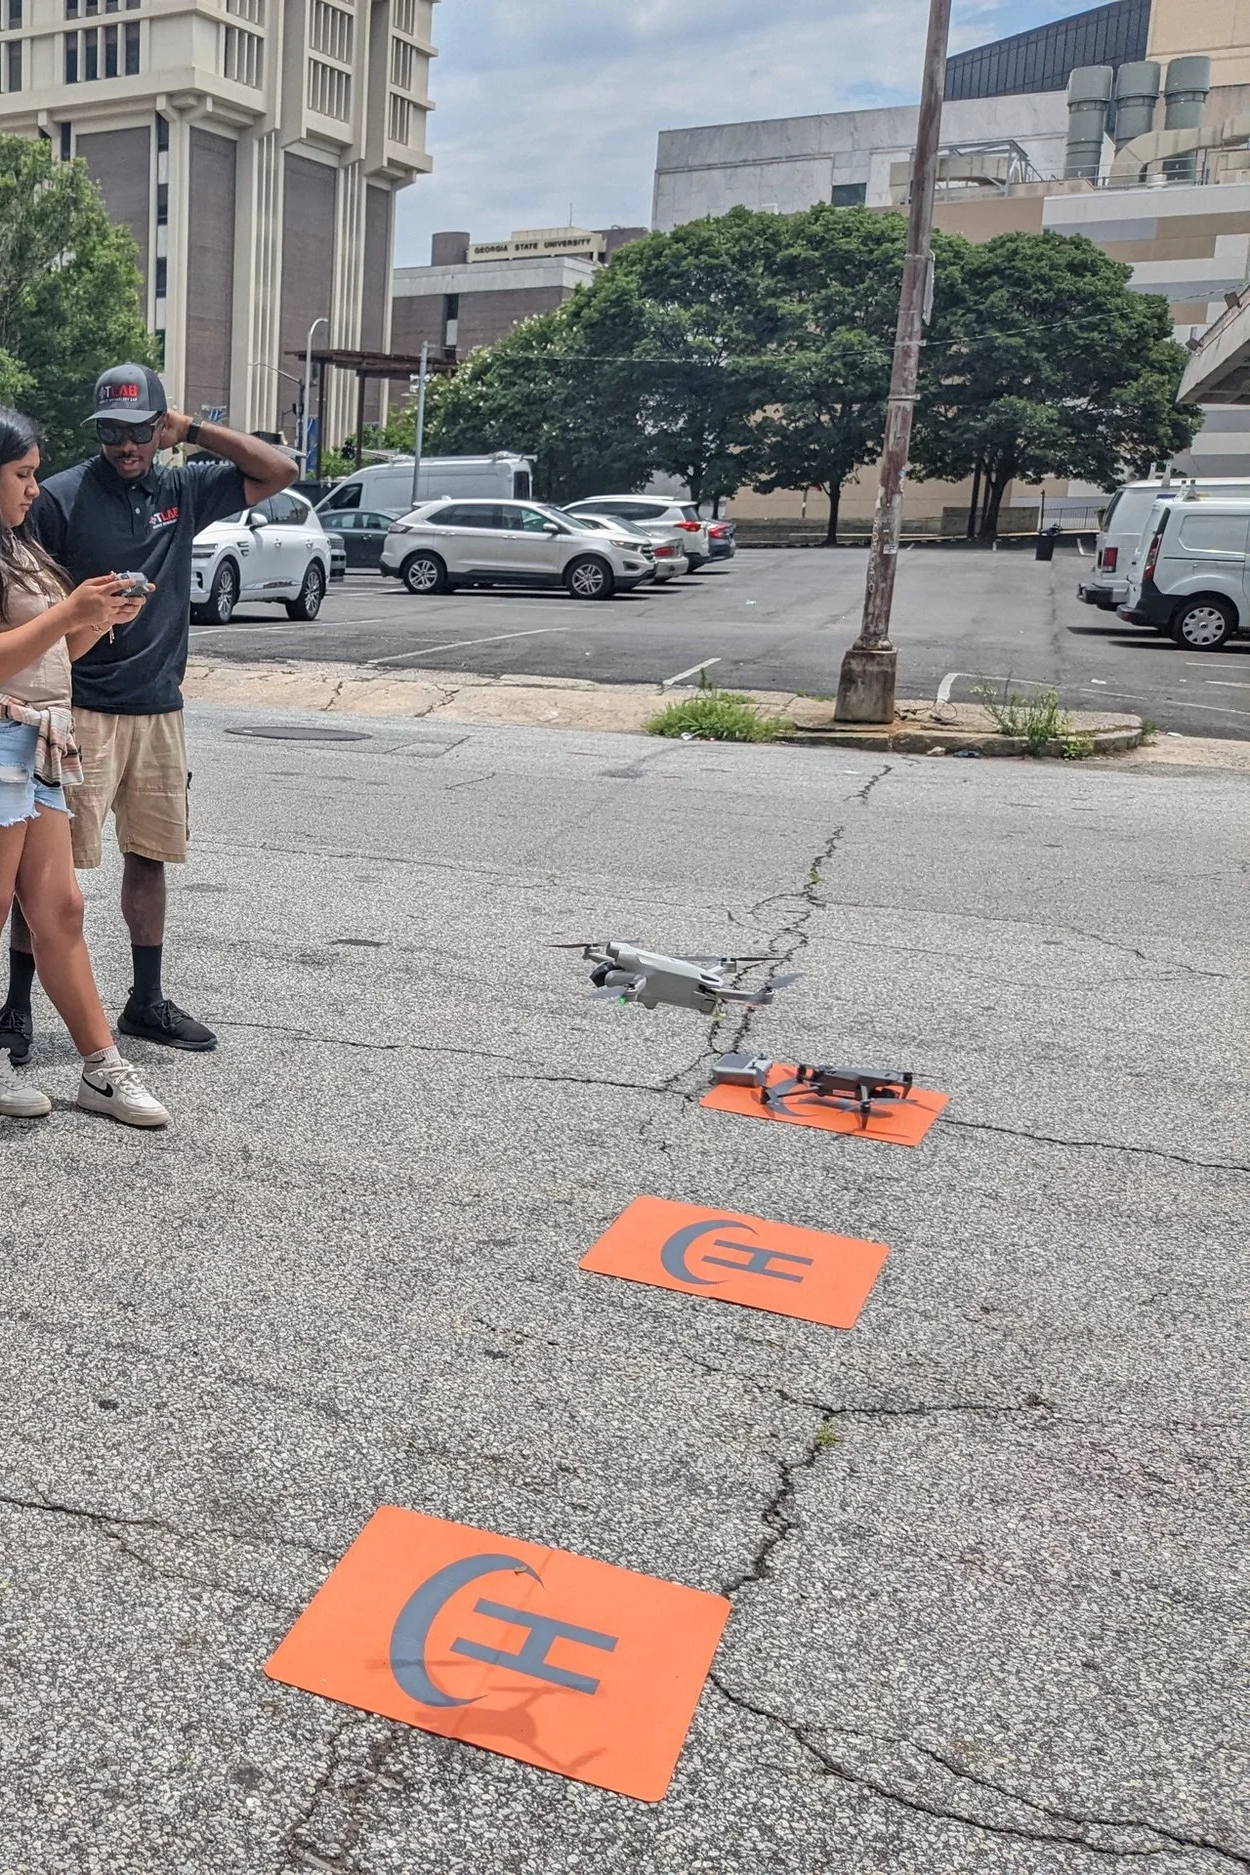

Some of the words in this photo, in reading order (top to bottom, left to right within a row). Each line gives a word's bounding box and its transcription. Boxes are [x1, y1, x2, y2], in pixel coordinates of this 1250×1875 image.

[474, 245, 508, 254] GEORGIA
[514, 242, 538, 251] STATE
[544, 239, 591, 249] UNIVERSITY
